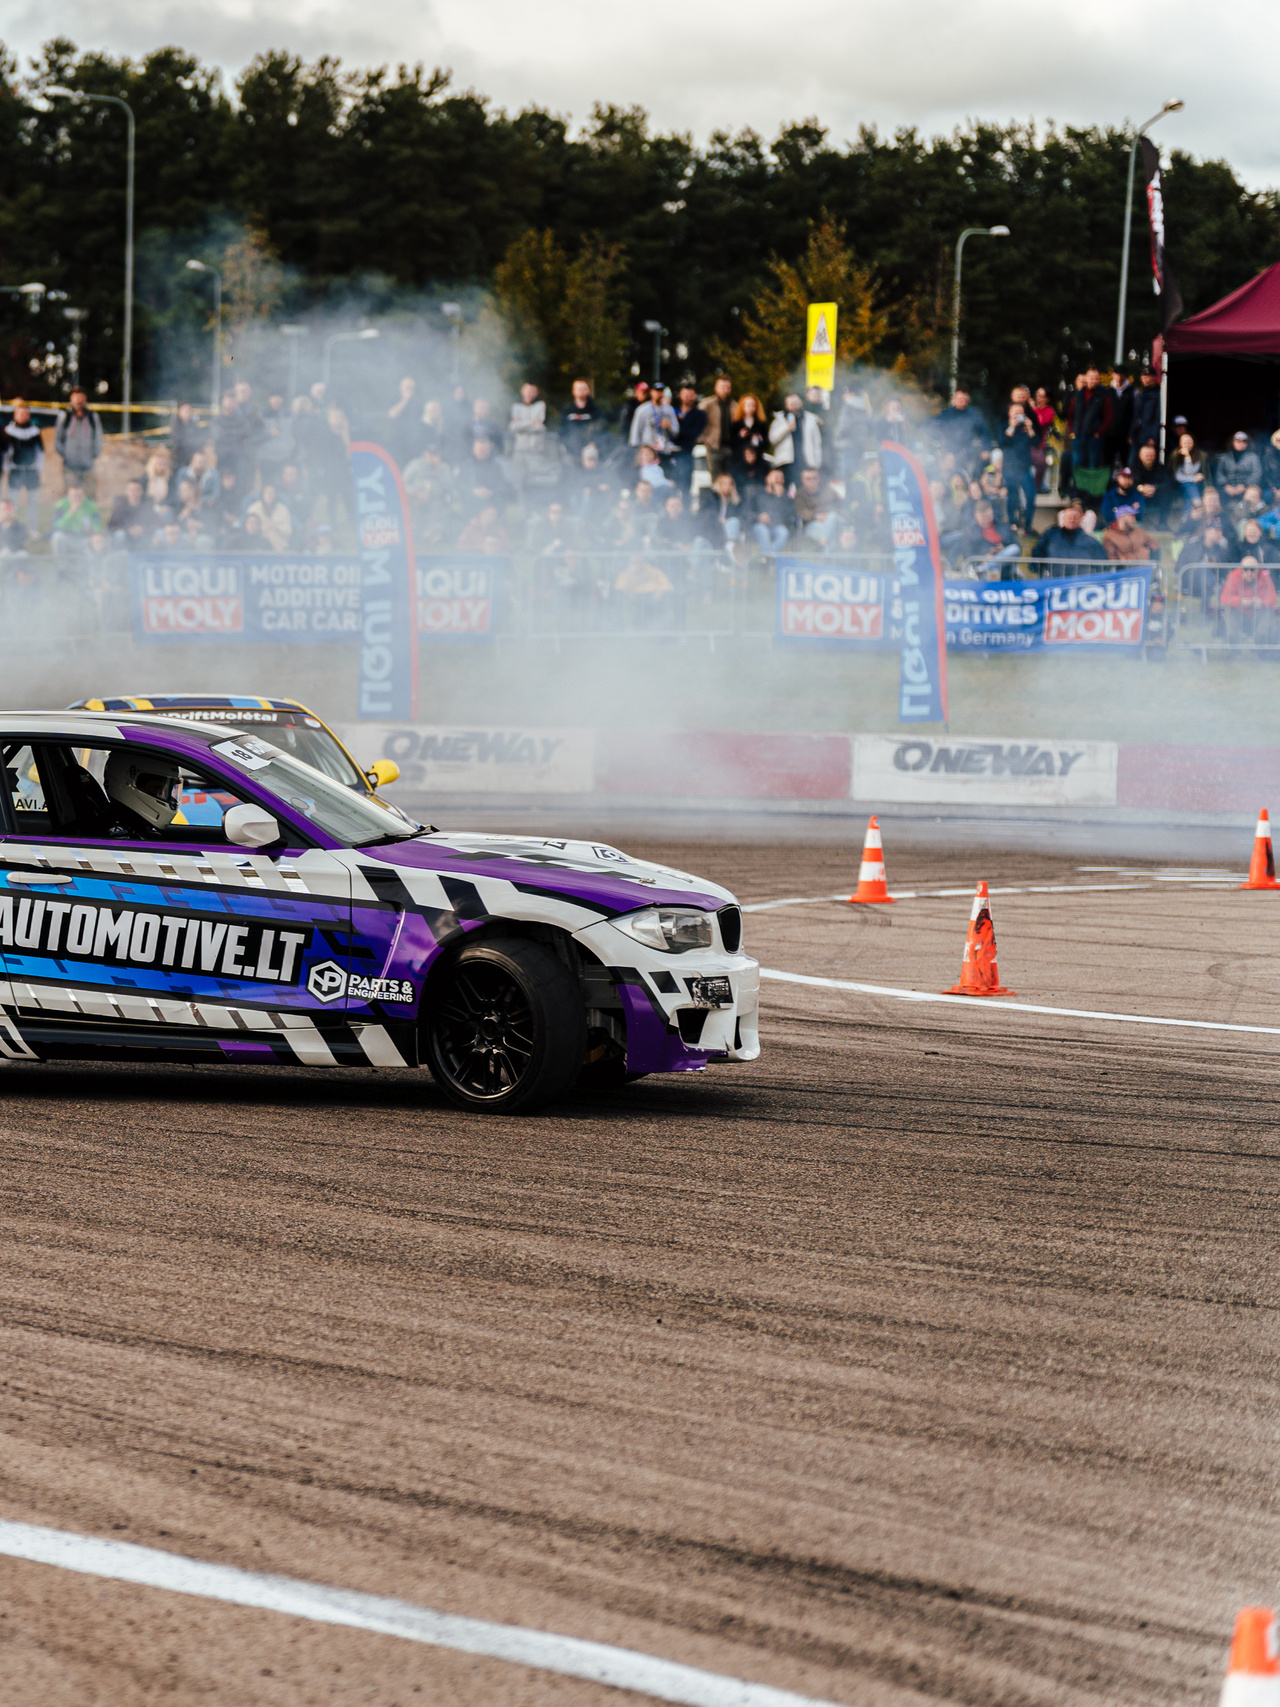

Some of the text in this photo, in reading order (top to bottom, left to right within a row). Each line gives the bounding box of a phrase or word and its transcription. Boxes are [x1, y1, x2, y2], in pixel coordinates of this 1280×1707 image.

[144, 567, 237, 596] LIQUI
[250, 564, 329, 586] MOTOR
[416, 568, 487, 597] IQUI
[787, 572, 879, 604] LIQUI
[982, 588, 1039, 604] OILS
[1049, 581, 1140, 612] LIQUI
[147, 599, 241, 629] MOLY
[261, 610, 363, 631] CAR CAR
[418, 600, 487, 628] OLY
[785, 604, 880, 637] MOLY
[946, 603, 1039, 625] DITIVES
[1045, 609, 1142, 643] MOLY
[960, 628, 1035, 648] Germany
[231, 749, 253, 761] 18
[348, 987, 413, 1003] ENGINEERING
[349, 974, 413, 995] PARTS &
